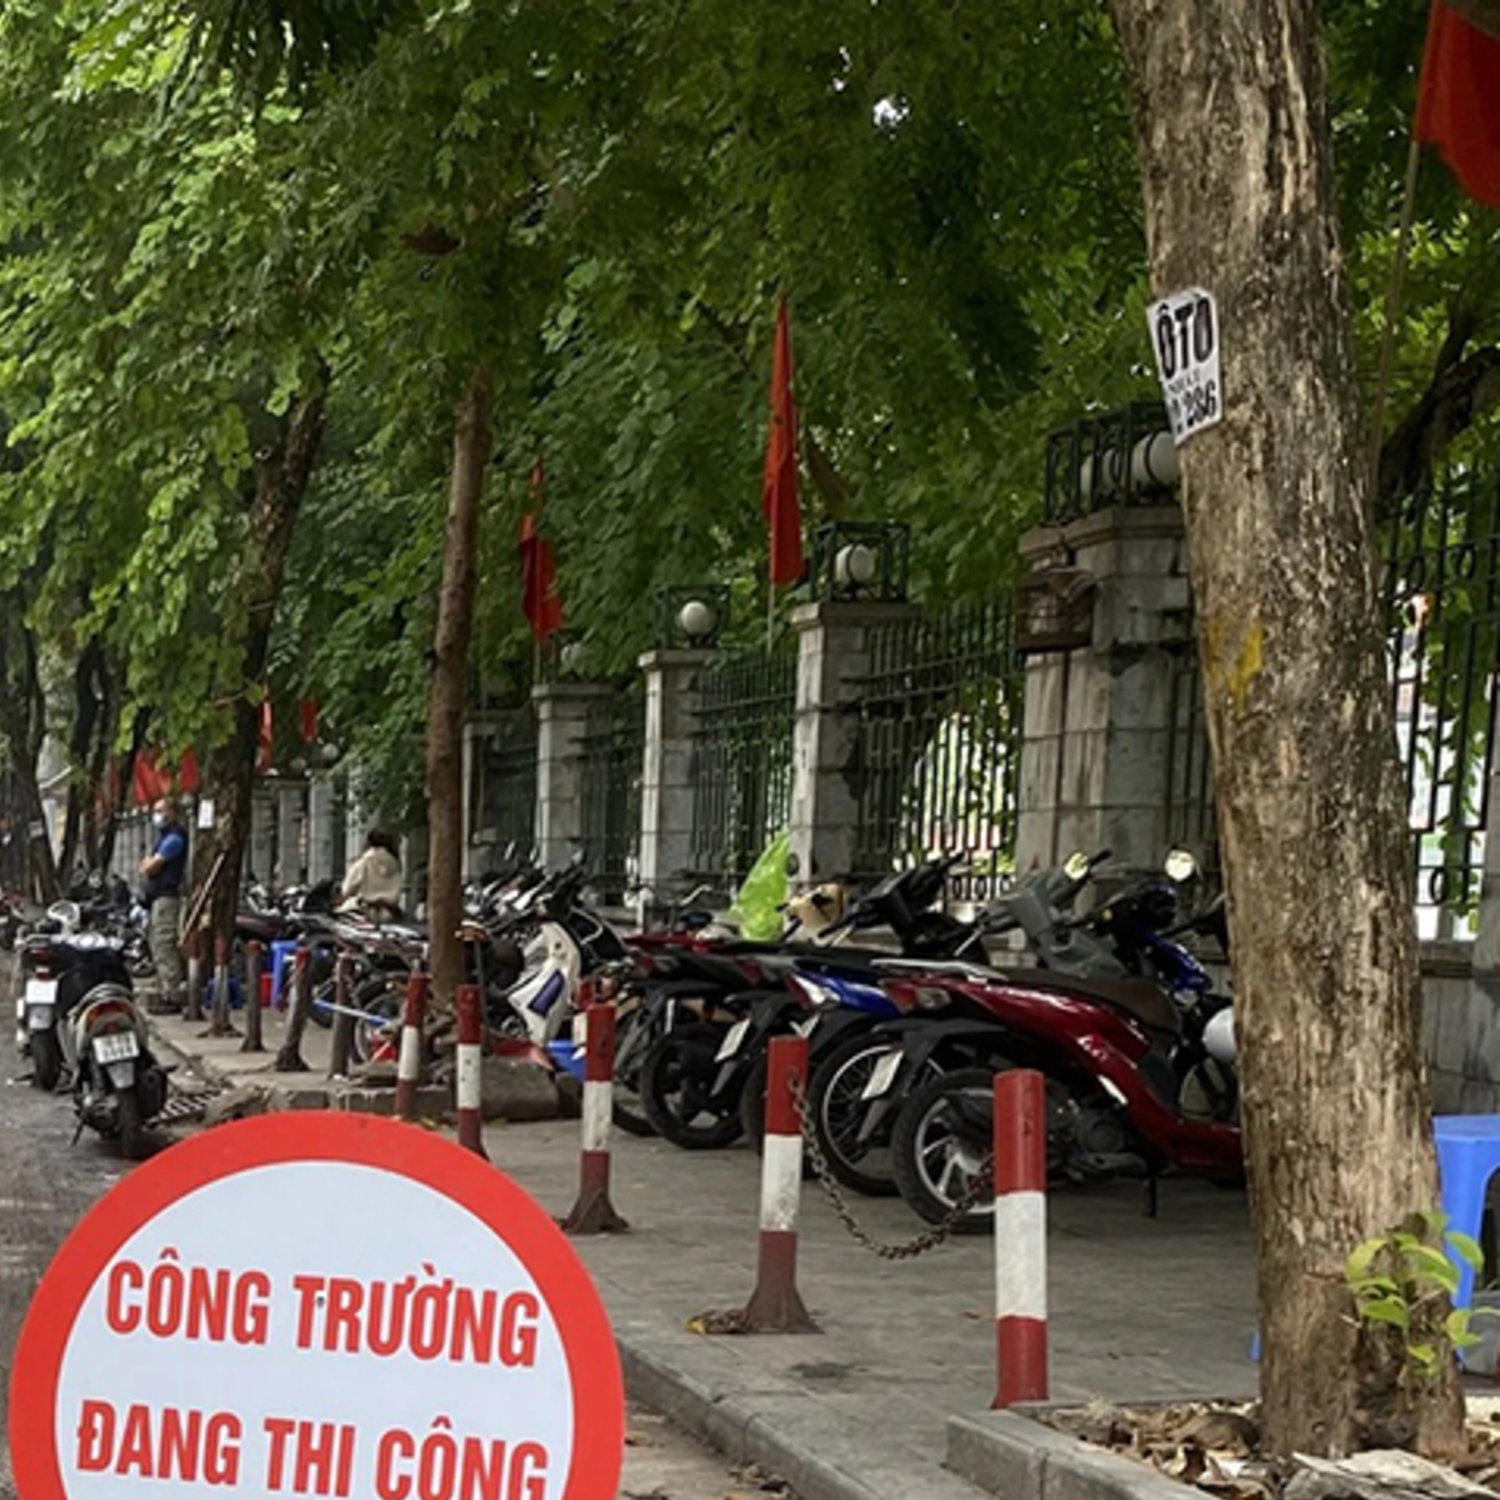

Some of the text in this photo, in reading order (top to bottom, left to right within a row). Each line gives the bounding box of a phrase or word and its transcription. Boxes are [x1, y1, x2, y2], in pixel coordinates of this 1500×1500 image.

[105, 1247, 541, 1368] CÔNG TRƯỜNG
[76, 1400, 243, 1487] ĐANG
[263, 1418, 356, 1498] THI
